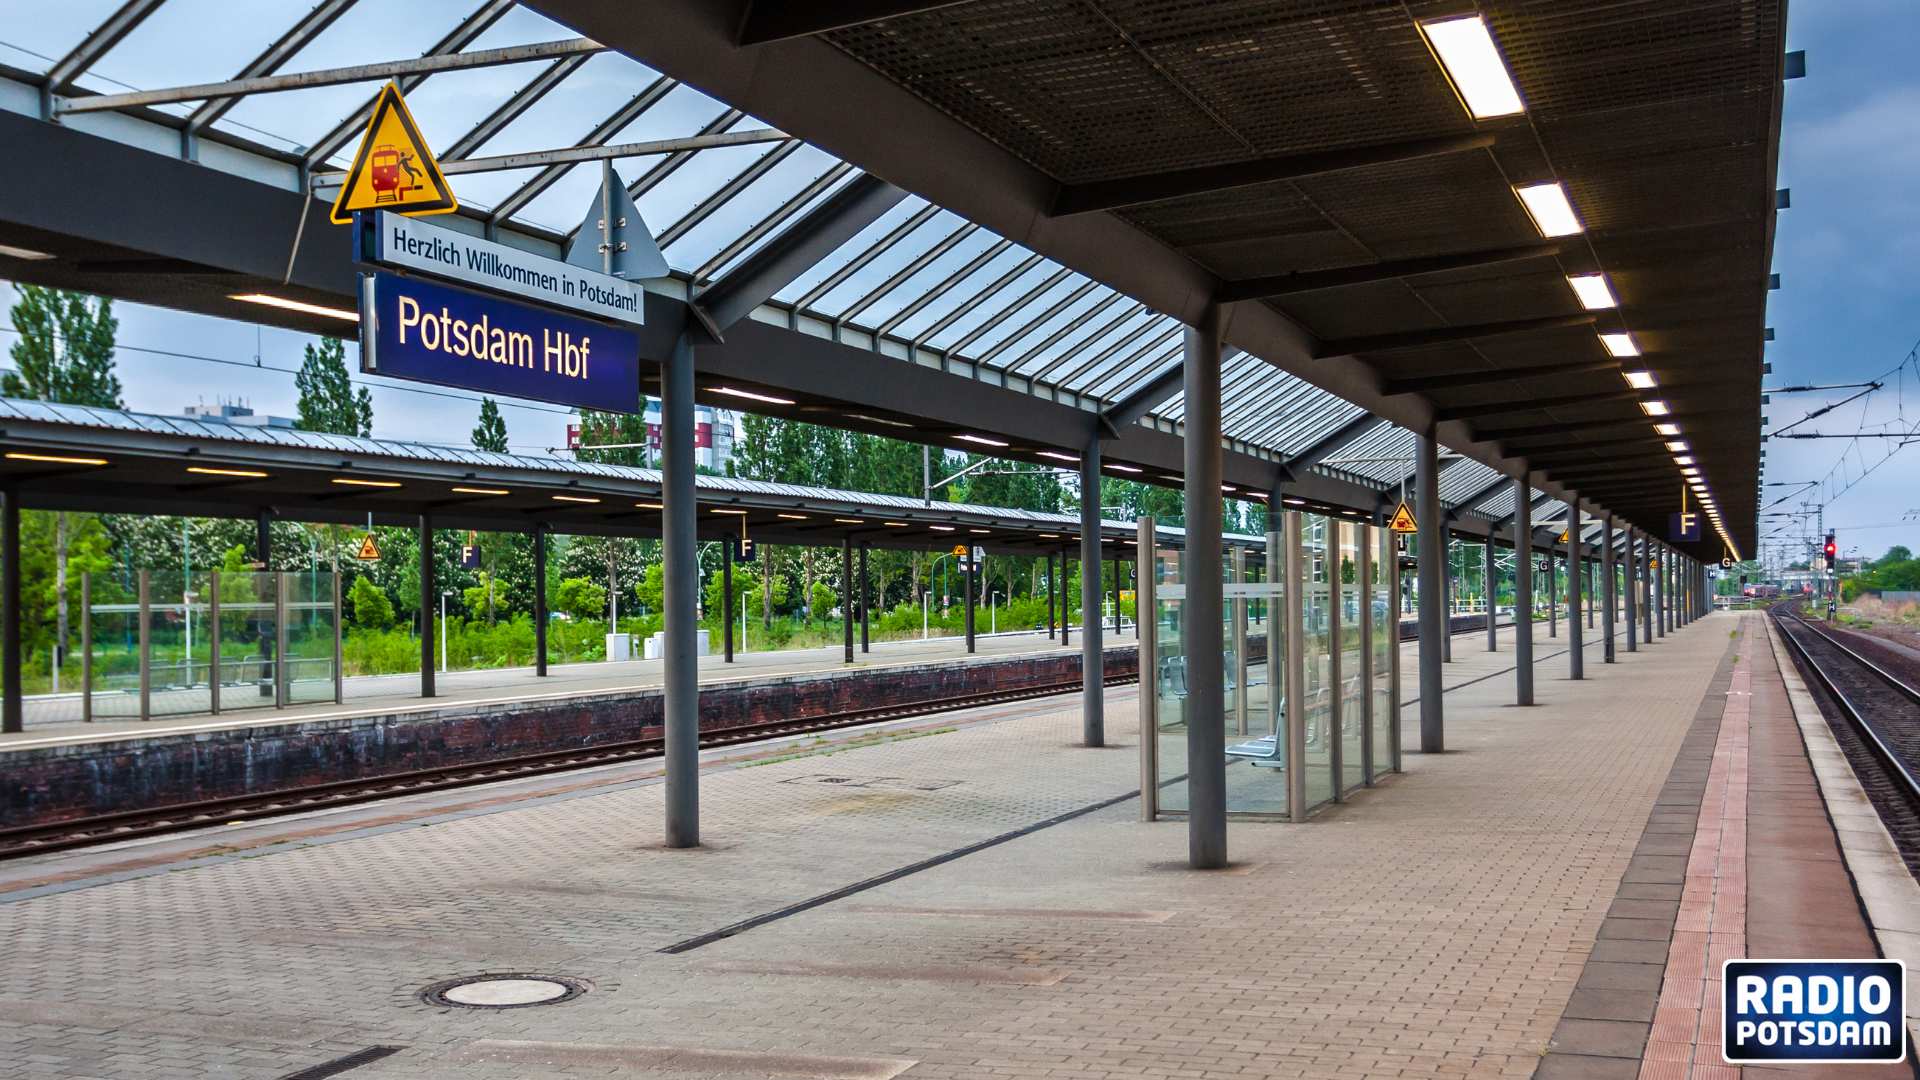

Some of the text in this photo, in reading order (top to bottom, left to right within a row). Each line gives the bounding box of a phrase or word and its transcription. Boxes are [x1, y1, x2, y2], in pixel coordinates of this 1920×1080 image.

[394, 227, 638, 313] Herzlich Willkommen in Potsdam!
[398, 295, 590, 380] Potsdam Hbf
[1681, 514, 1696, 535] F
[463, 546, 473, 563] F
[742, 539, 752, 556] F
[1540, 561, 1548, 570] G
[1722, 558, 1731, 568] G
